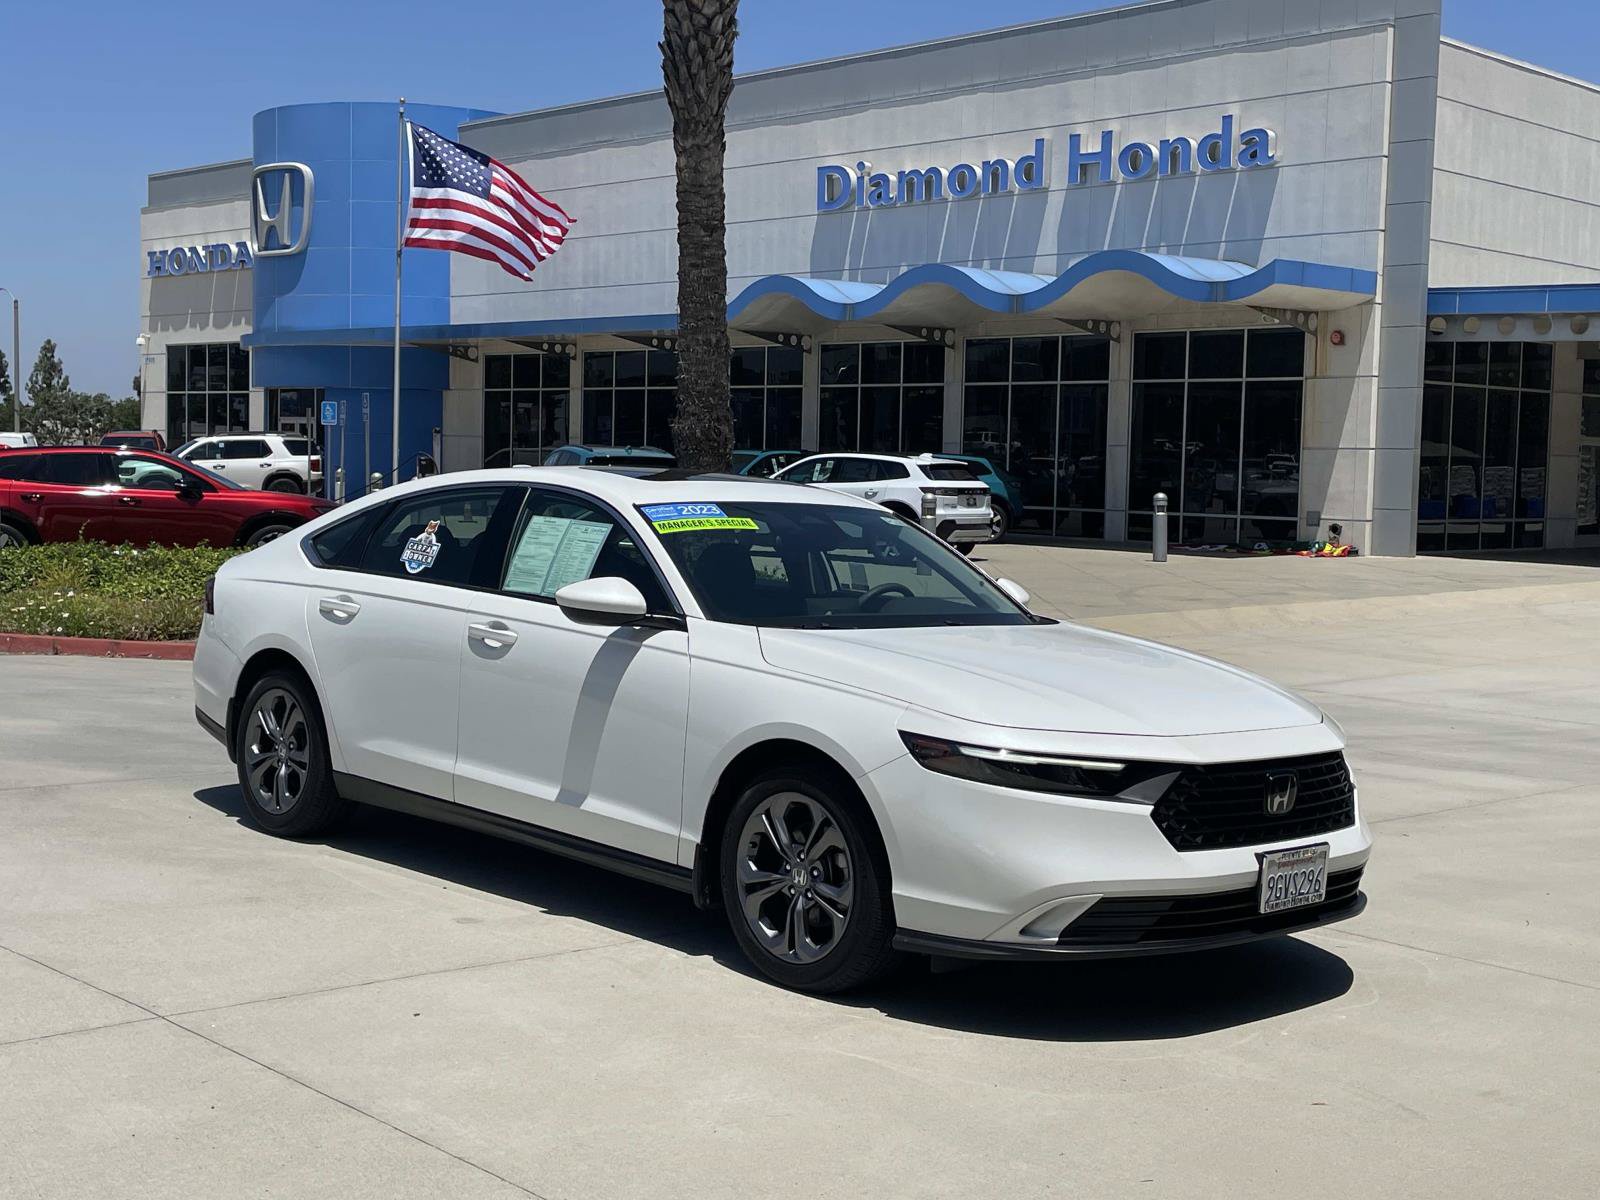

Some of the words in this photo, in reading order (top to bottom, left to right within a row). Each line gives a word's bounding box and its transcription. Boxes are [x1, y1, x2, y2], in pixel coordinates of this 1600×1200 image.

[816, 138, 1048, 213] Diamond
[1067, 114, 1277, 185] Honda
[147, 241, 255, 278] HONDA
[677, 505, 721, 516] 2023
[657, 519, 714, 531] MANAGER'S
[714, 518, 754, 528] SPECIAL
[409, 551, 433, 563] OWNER
[1266, 866, 1324, 903] 9GVS296
